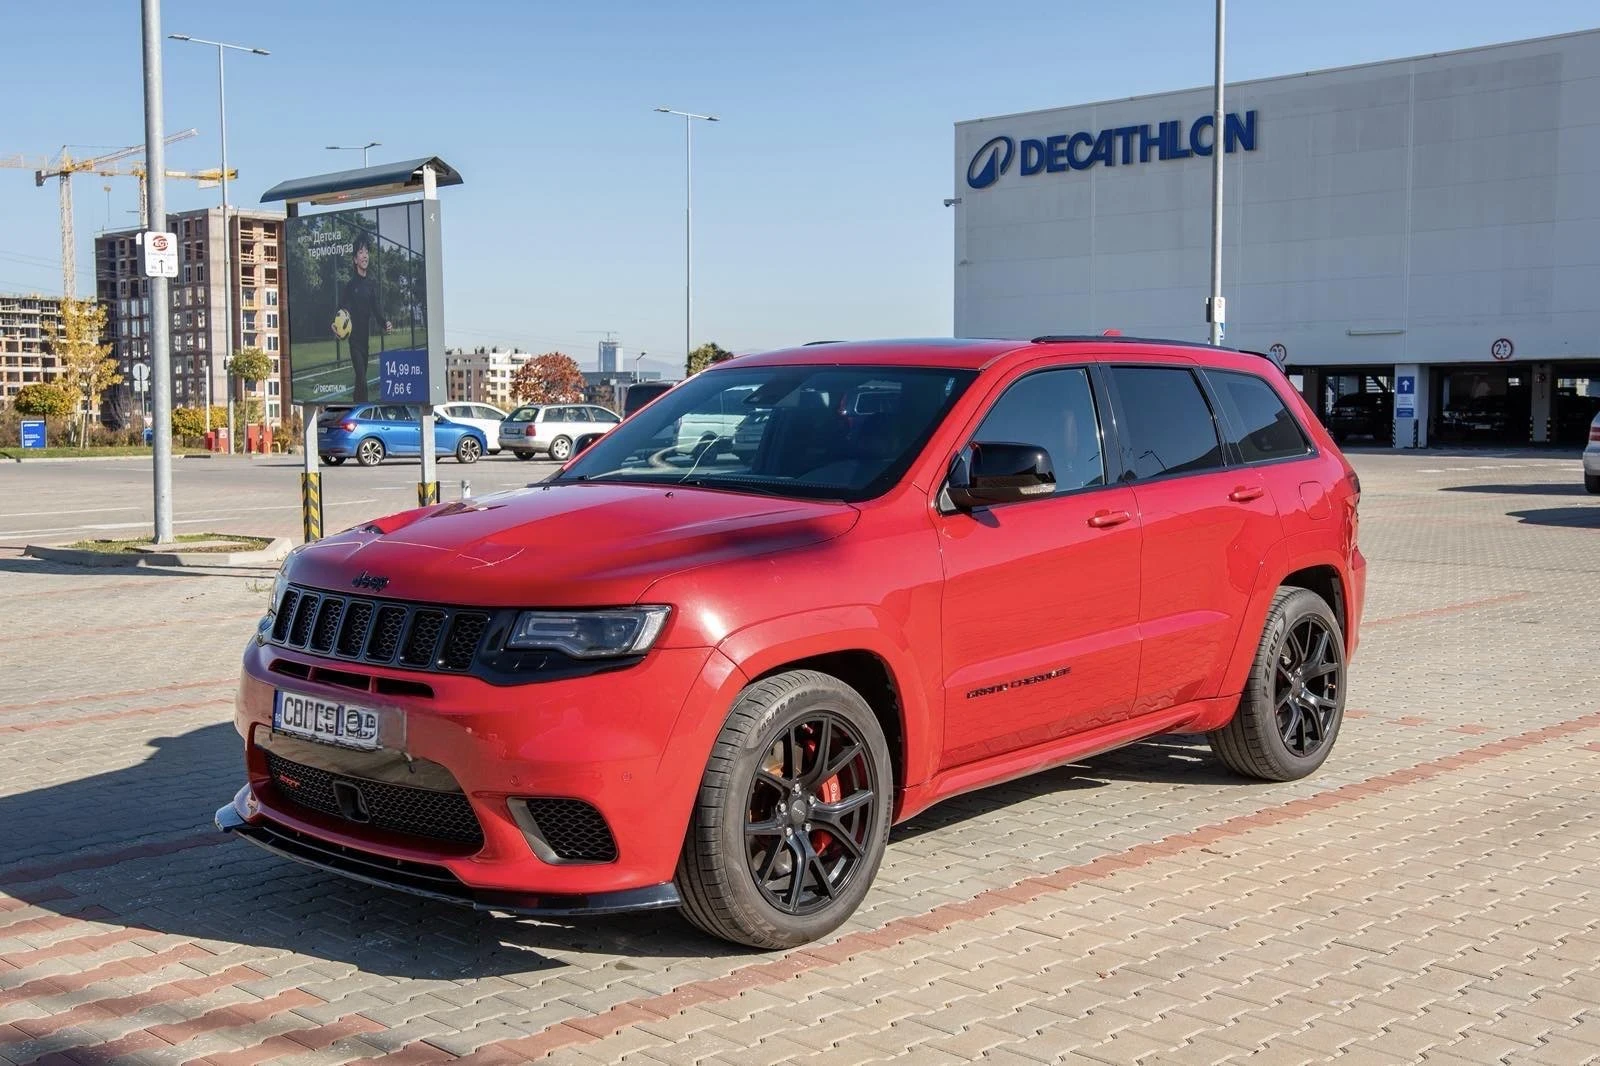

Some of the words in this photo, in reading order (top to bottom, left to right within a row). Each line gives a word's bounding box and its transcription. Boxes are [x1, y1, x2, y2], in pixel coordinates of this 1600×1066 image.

[1020, 110, 1257, 177] DECATHLON
[313, 230, 342, 245] Детска
[308, 243, 354, 260] термоблуза
[385, 361, 410, 378] 14,99
[411, 366, 423, 376] лв.
[386, 380, 405, 397] 7,66
[406, 382, 412, 394] €
